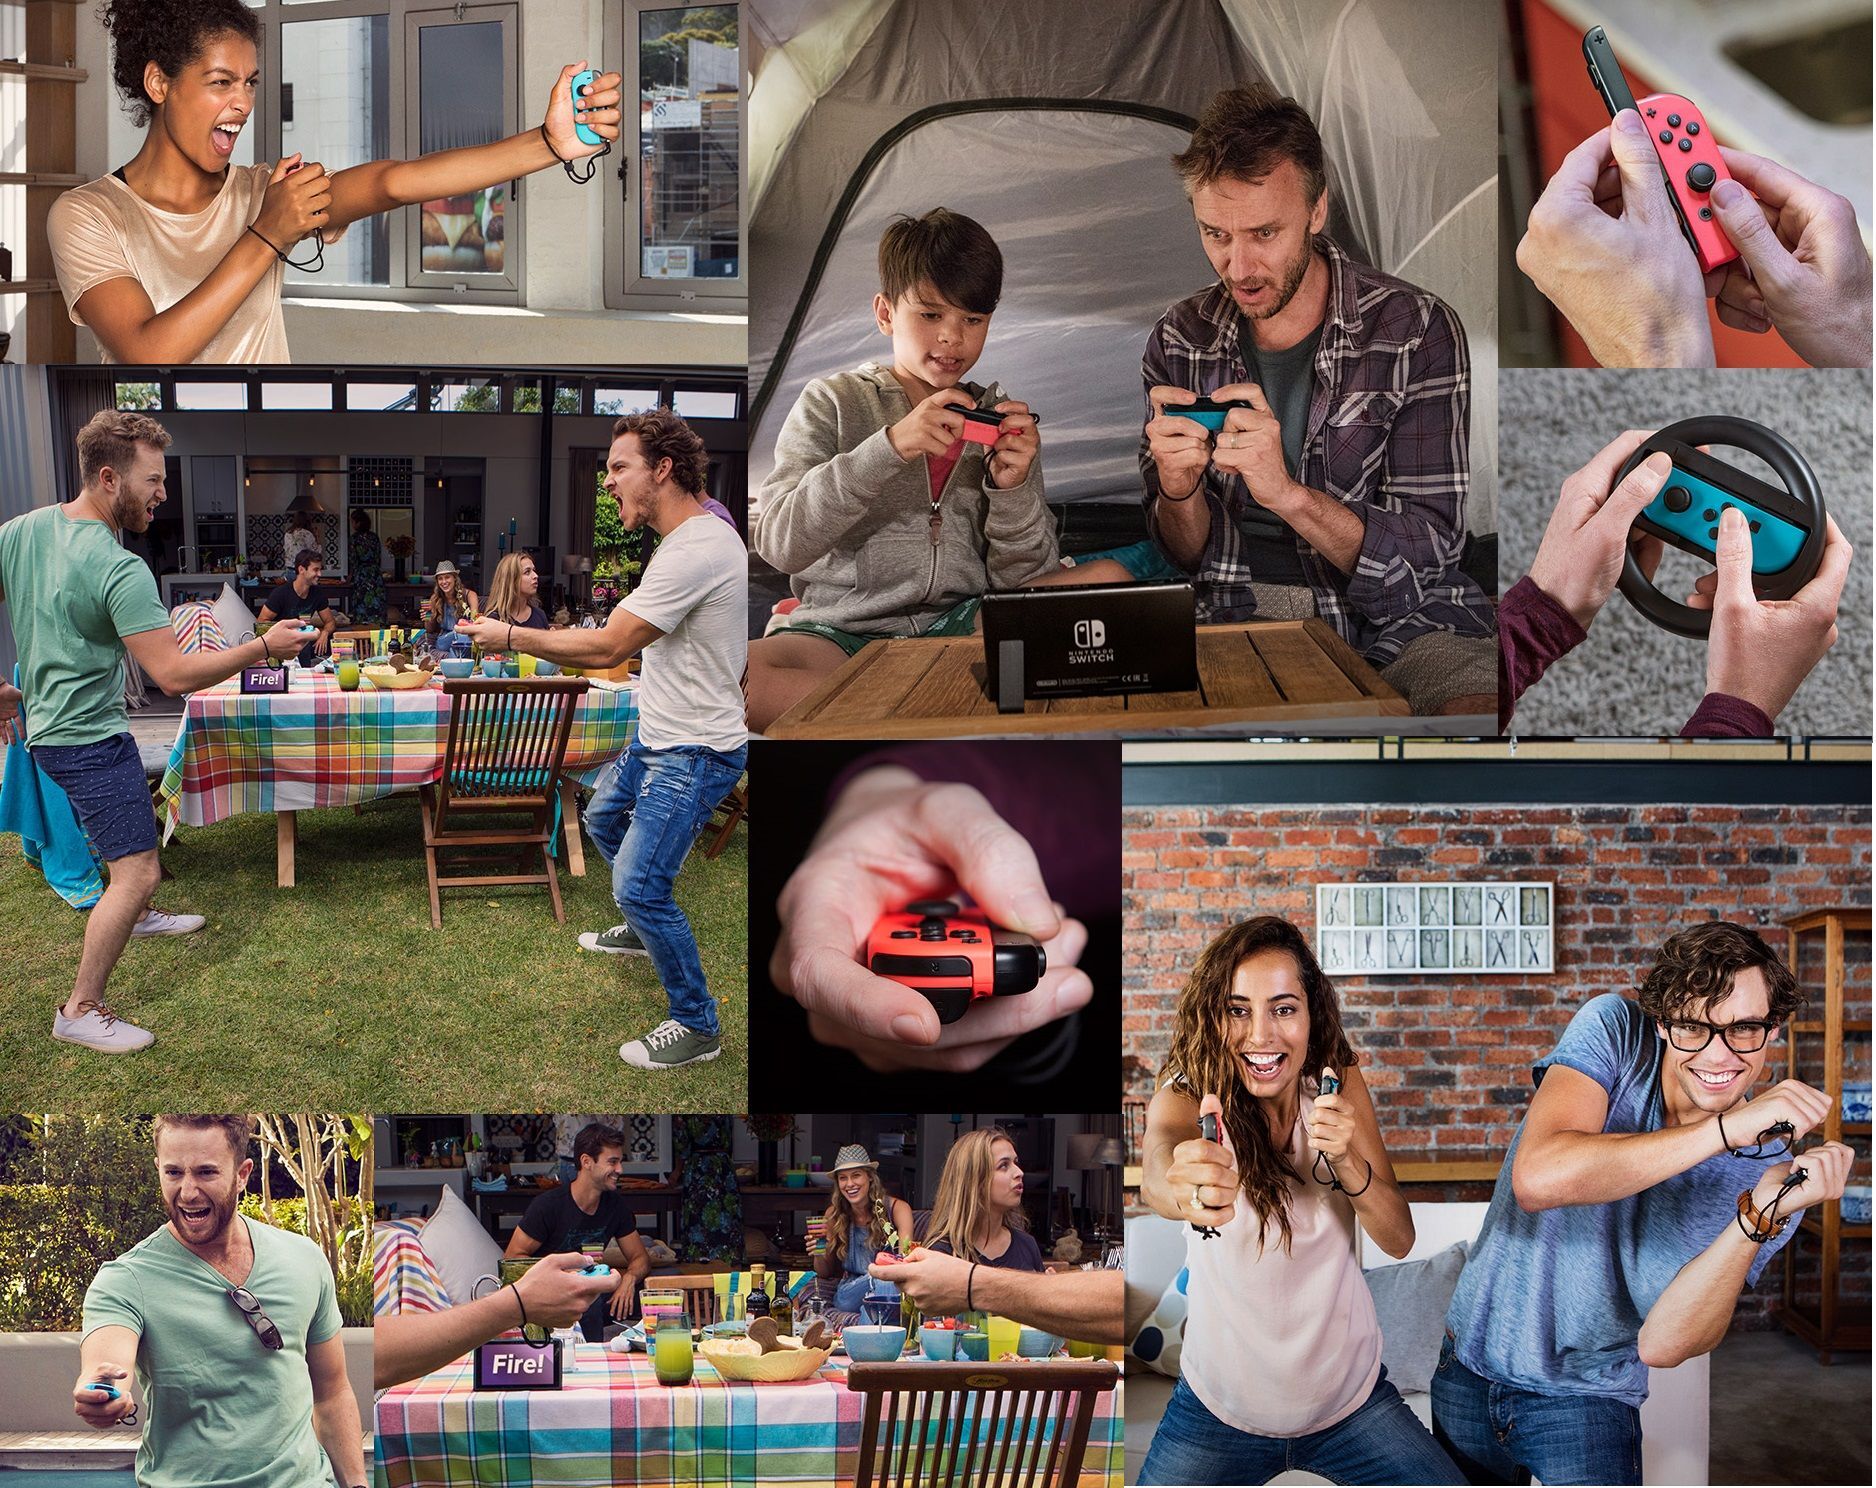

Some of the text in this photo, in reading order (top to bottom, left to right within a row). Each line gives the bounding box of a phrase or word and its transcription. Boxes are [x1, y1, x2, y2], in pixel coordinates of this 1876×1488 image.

[1068, 648, 1114, 656] NINTENDO
[1068, 654, 1114, 665] SWITCH
[250, 673, 279, 685] Fire!
[492, 1353, 545, 1375] Fire!
